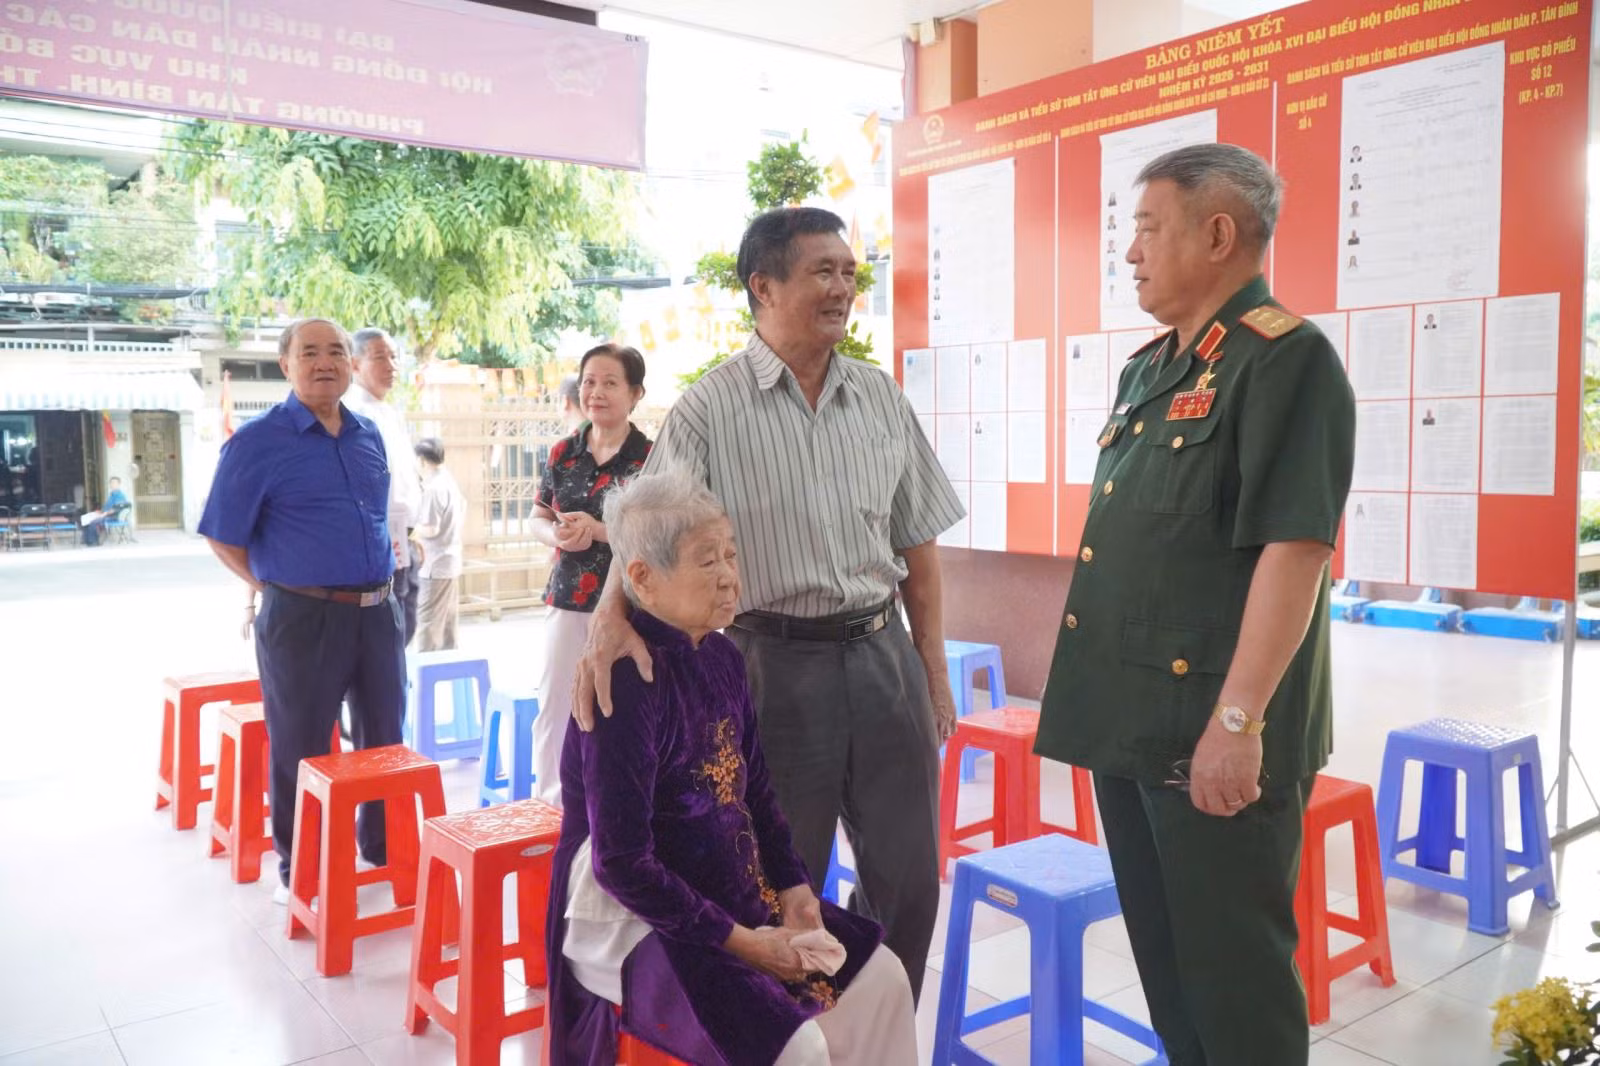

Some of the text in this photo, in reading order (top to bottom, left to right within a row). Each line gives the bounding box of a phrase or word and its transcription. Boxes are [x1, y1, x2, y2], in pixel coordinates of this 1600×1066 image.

[1491, 17, 1512, 35] NHÂN
[1513, 13, 1530, 29] DÂN
[1531, 12, 1539, 26] P.
[1541, 6, 1557, 22] TÂN
[1558, 1, 1579, 18] BÌNH
[1145, 14, 1286, 70] BẢNG NIÊM YẾT
[1509, 35, 1576, 65] KHU VỰC BỎ PHIẾU
[1031, 101, 1048, 118] TIỂU
[1049, 97, 1061, 112] SỬ
[1135, 74, 1157, 89] VIÊN
[1176, 60, 1200, 78] BIỂU
[1202, 52, 1230, 72] QUỐC
[1231, 47, 1250, 63] HỘI
[1253, 40, 1282, 57] KHÓA
[1285, 34, 1304, 49] XVI
[1306, 27, 1326, 44] ĐẠI
[1329, 17, 1357, 37] BIỂU
[1360, 12, 1381, 29] HỘI
[1384, 3, 1419, 23] ĐỒNG
[1243, 60, 1269, 76] 2031
[1531, 62, 1552, 80] SỐ 12
